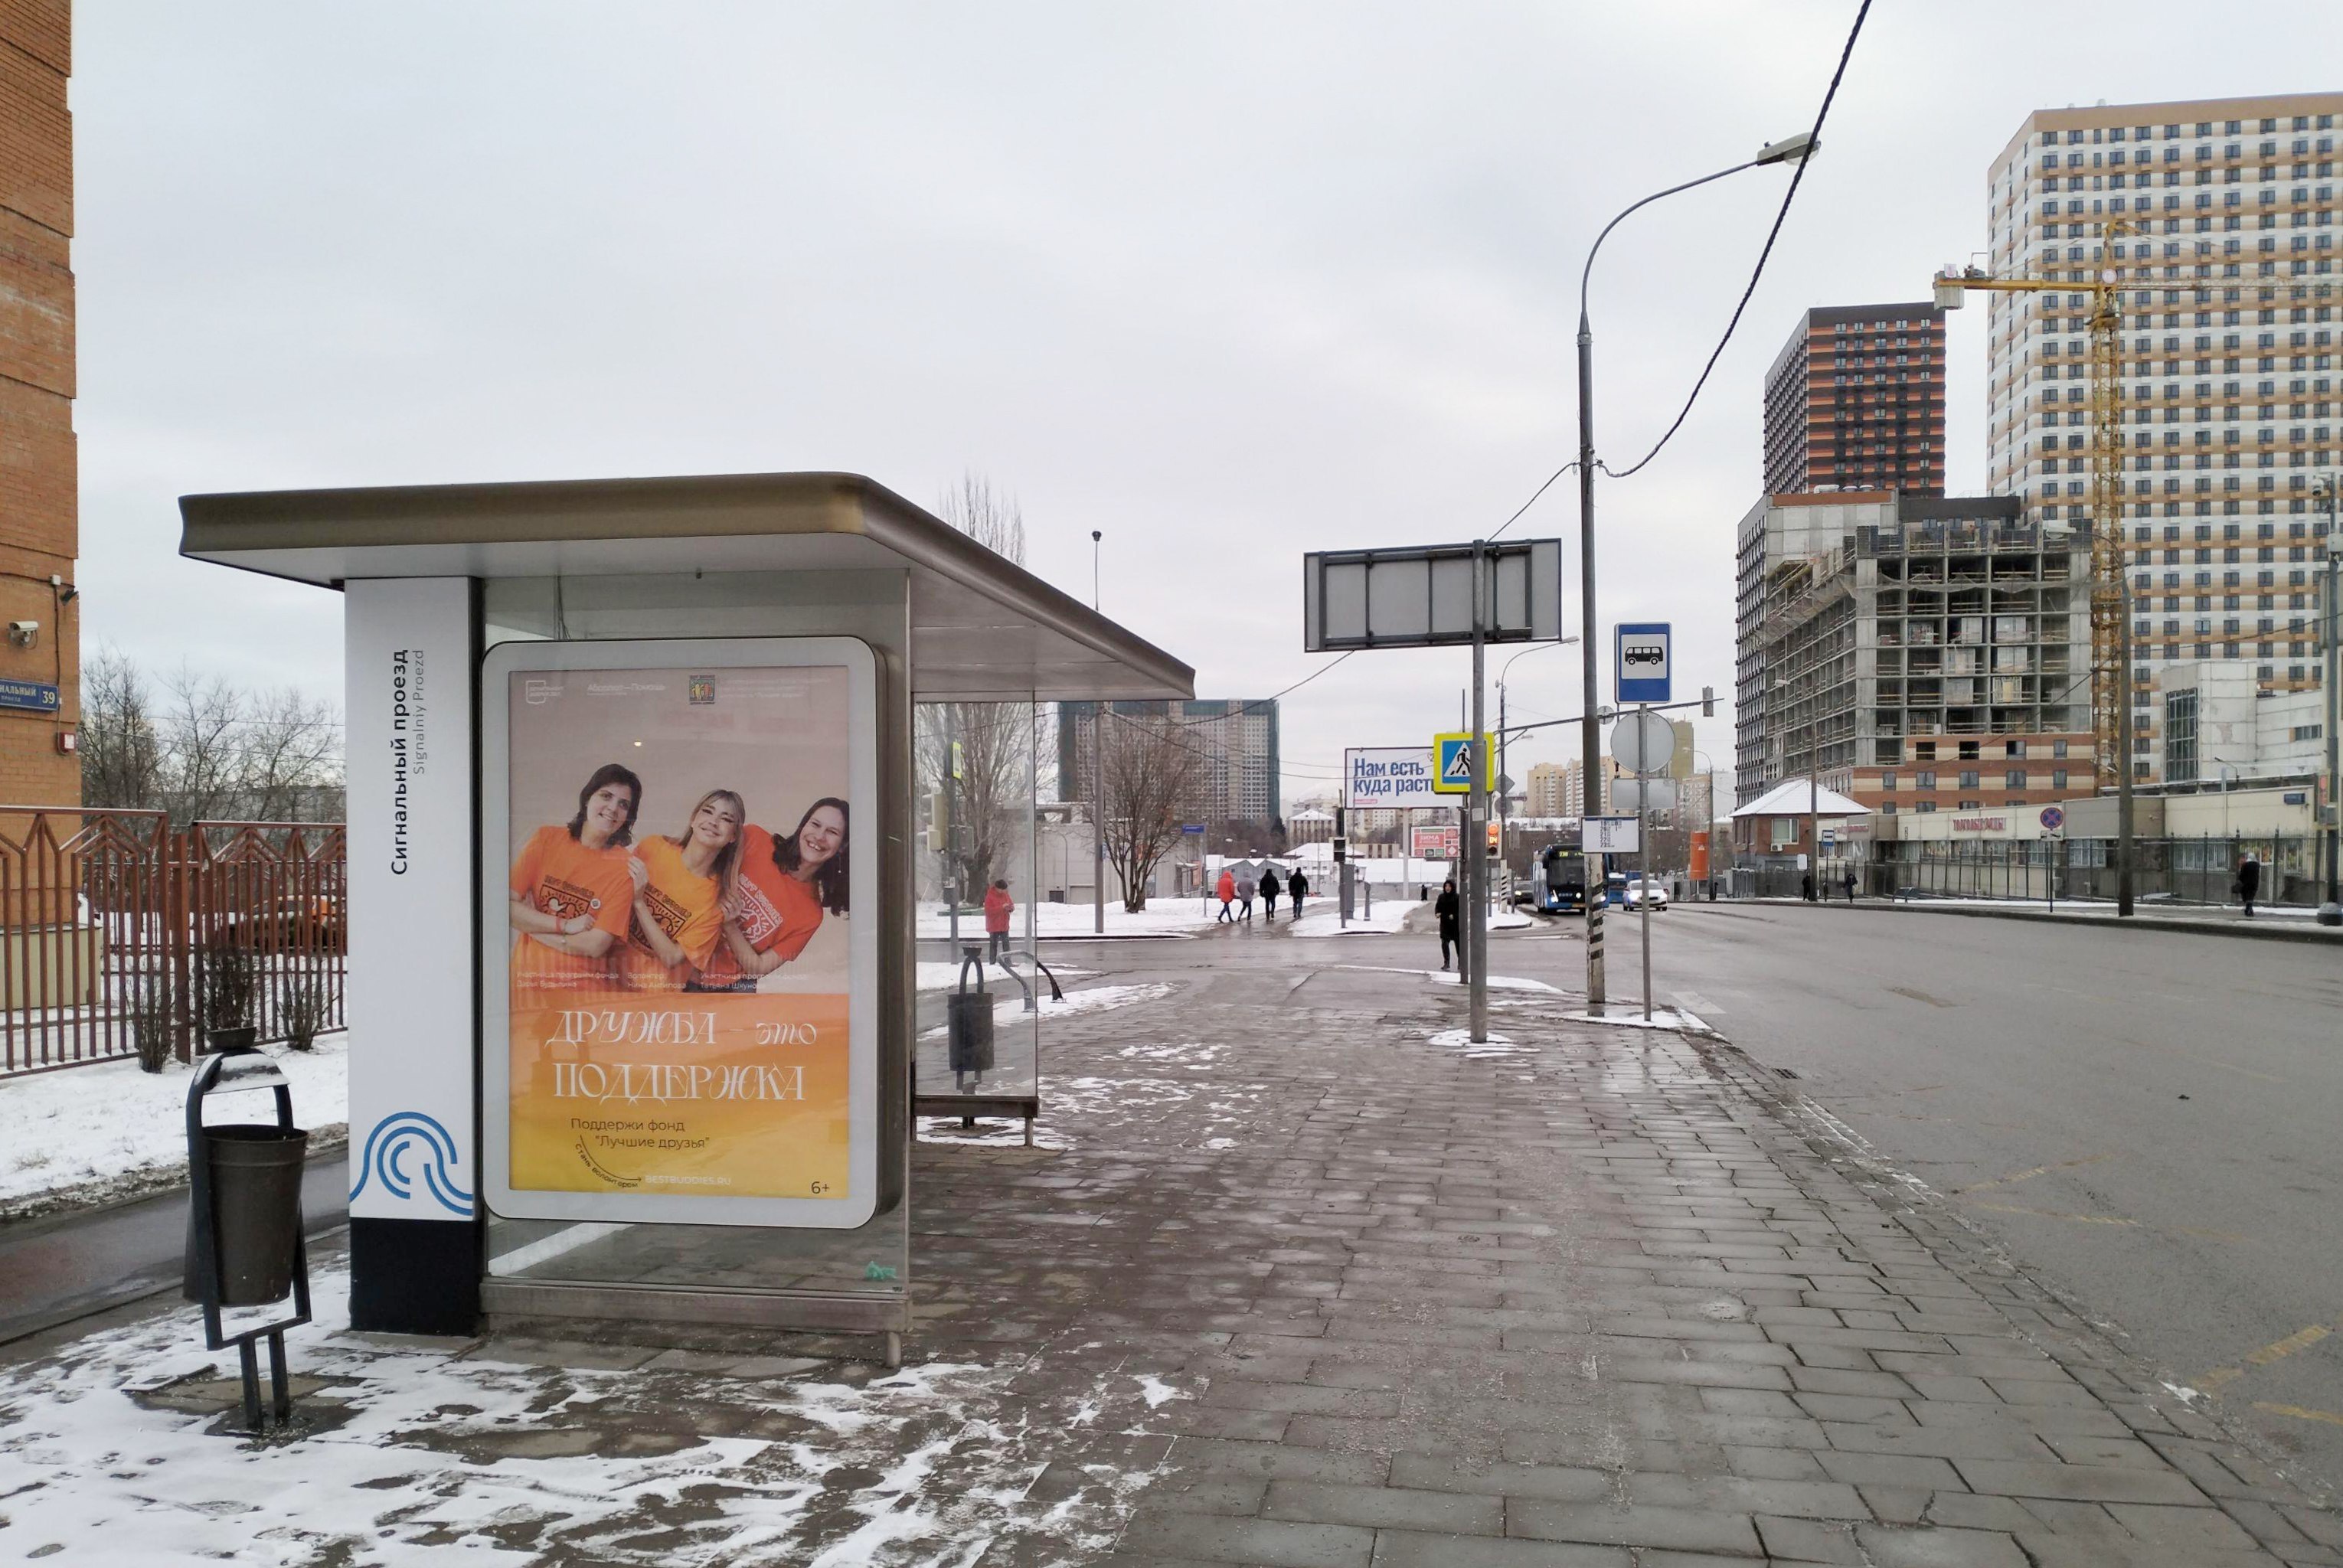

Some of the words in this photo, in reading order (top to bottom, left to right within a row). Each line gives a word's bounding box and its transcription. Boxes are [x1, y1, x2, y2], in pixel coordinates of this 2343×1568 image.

[413, 650, 424, 701] Proezd
[42, 691, 56, 704] 39
[393, 649, 410, 730] проезд
[413, 704, 427, 775] Signalniy
[1354, 758, 1386, 776] Нам
[1390, 762, 1424, 776] есть
[1354, 778, 1391, 796] куда
[390, 737, 407, 875] Сигнальный
[544, 1010, 717, 1049] ДРУЖБА
[756, 1023, 817, 1045] это
[553, 1061, 807, 1106] ПОДДЕРЖКА
[571, 1118, 644, 1132] Поддержи
[647, 1119, 685, 1133] фонд
[591, 1167, 639, 1189] волонтером
[644, 1174, 731, 1185] BESTBUDDIES.RU
[811, 1181, 830, 1194] 6+
